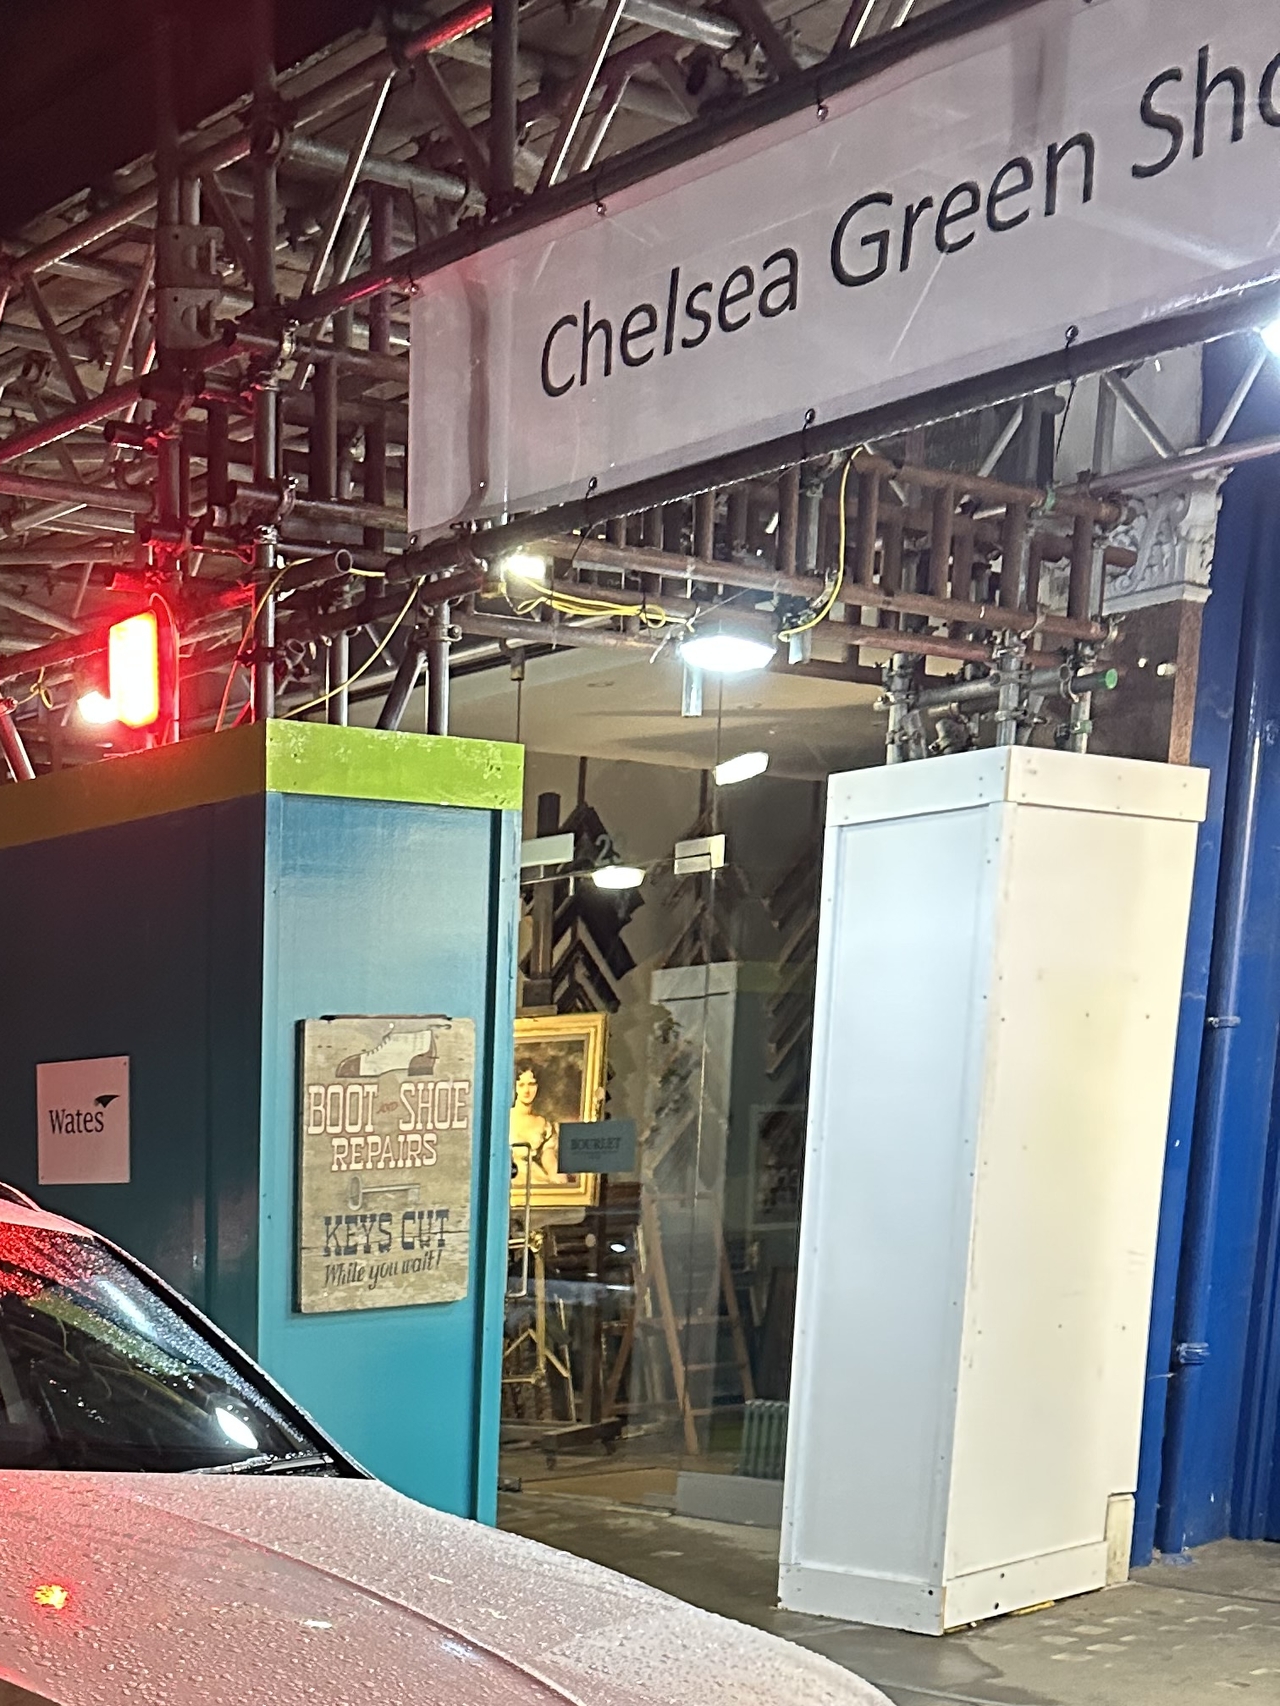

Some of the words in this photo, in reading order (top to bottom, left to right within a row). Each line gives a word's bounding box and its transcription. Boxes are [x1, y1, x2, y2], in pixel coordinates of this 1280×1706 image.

[540, 246, 799, 398] Chelsea
[829, 130, 1097, 288] Green
[48, 1109, 104, 1135] Wates
[307, 1083, 379, 1135] BOOT
[398, 1080, 470, 1132] SHOE
[331, 1133, 438, 1172] REPAIRS
[322, 1212, 393, 1257] KEYS
[401, 1209, 449, 1250] CUT
[324, 1261, 366, 1288] While
[368, 1260, 398, 1290] you
[401, 1249, 443, 1275] wait!
